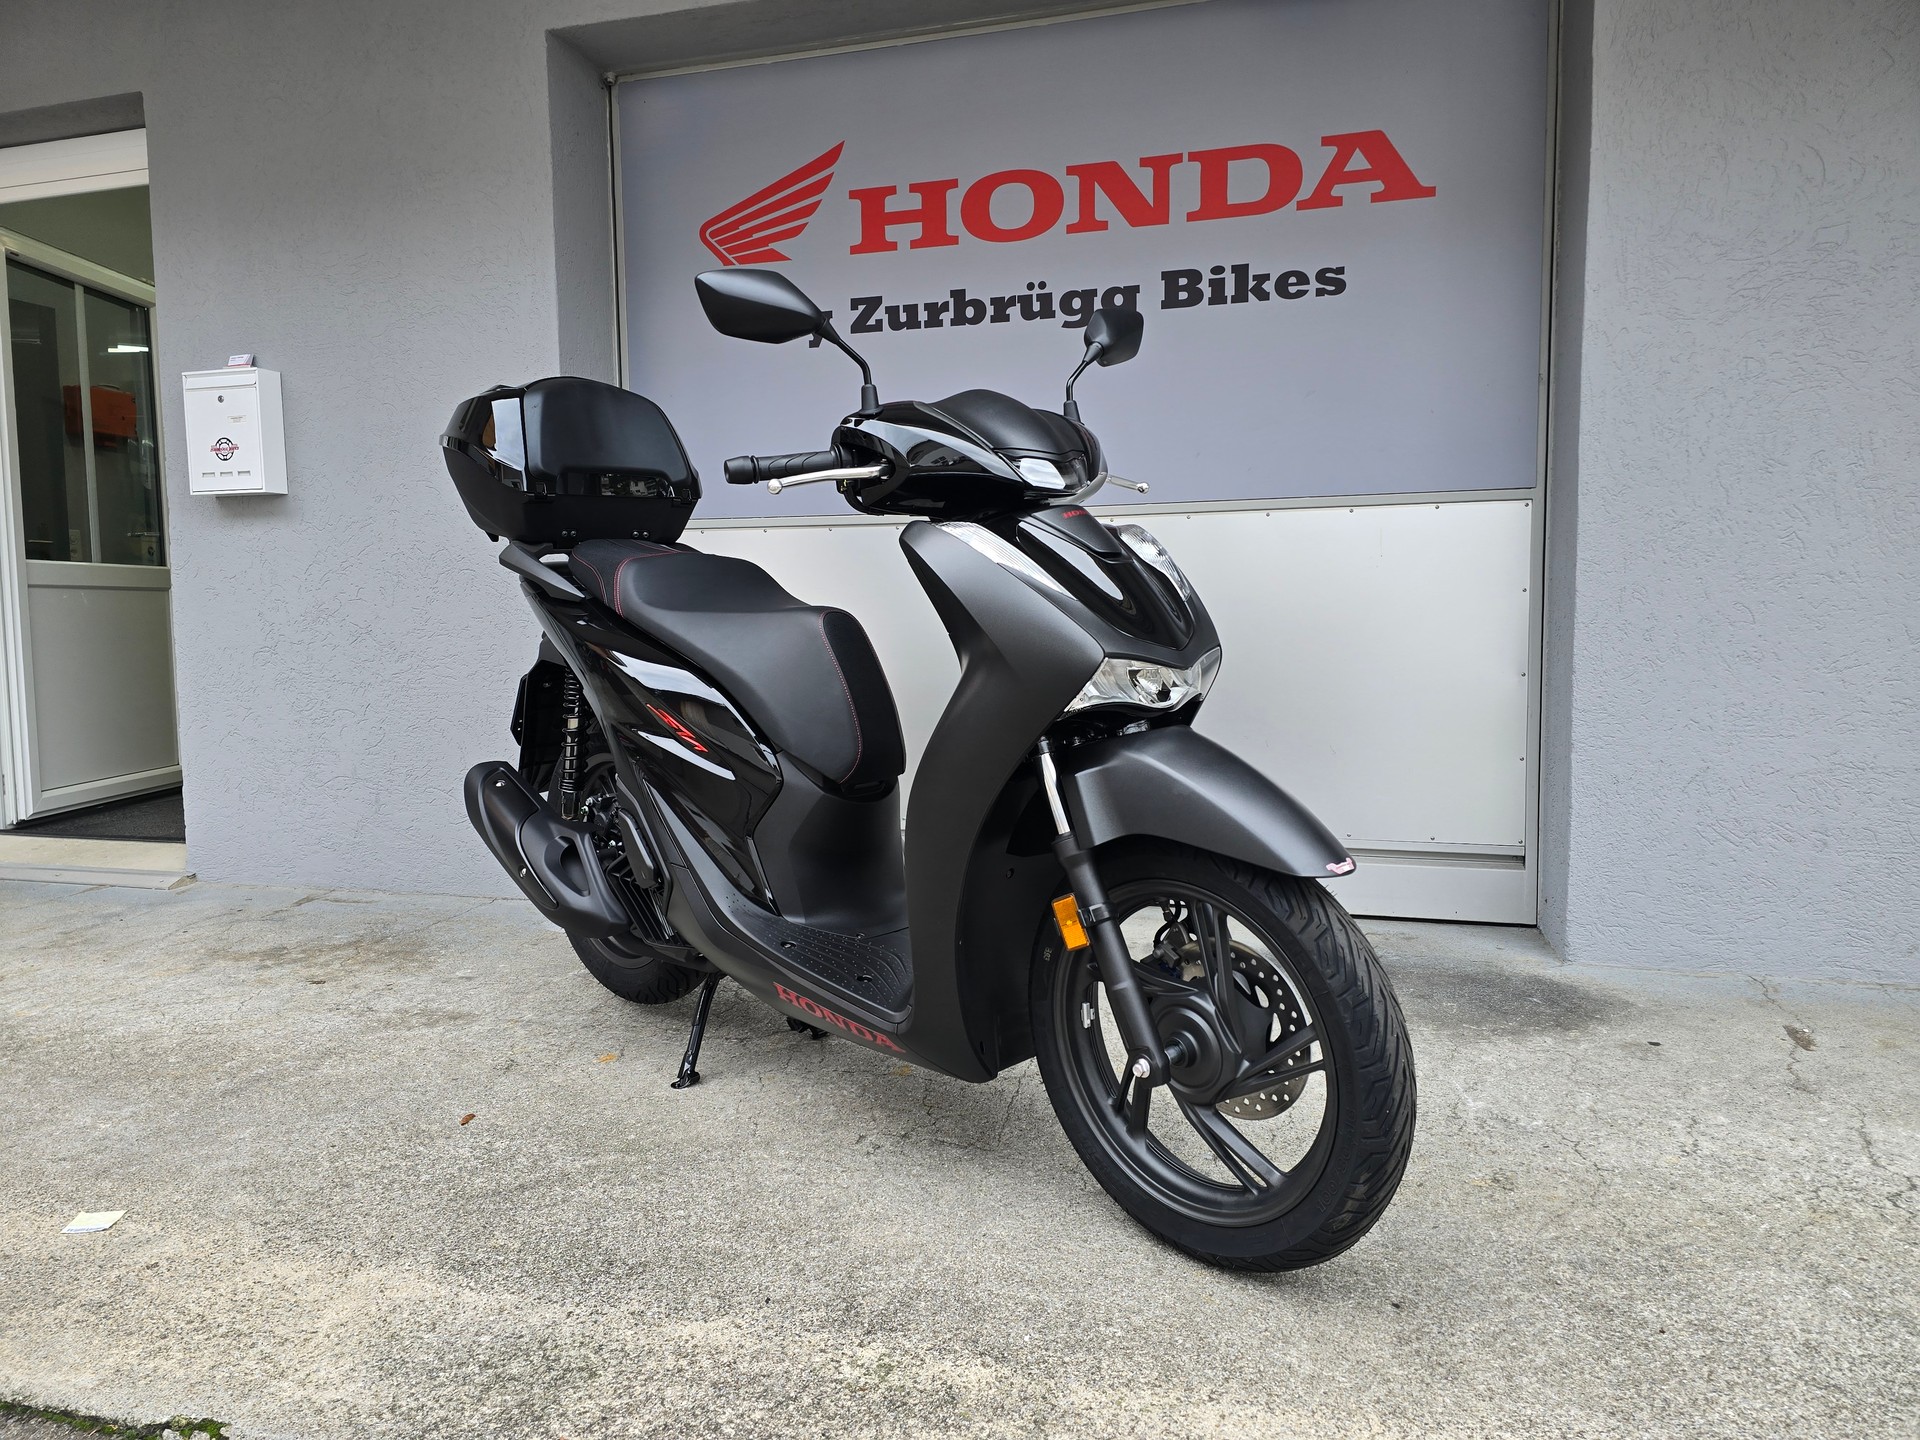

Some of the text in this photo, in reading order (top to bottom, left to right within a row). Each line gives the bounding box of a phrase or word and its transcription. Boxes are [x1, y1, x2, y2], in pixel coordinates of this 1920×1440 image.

[849, 129, 1436, 255] HONDA
[1160, 263, 1347, 310] Bikes
[772, 981, 907, 1054] HONDA
